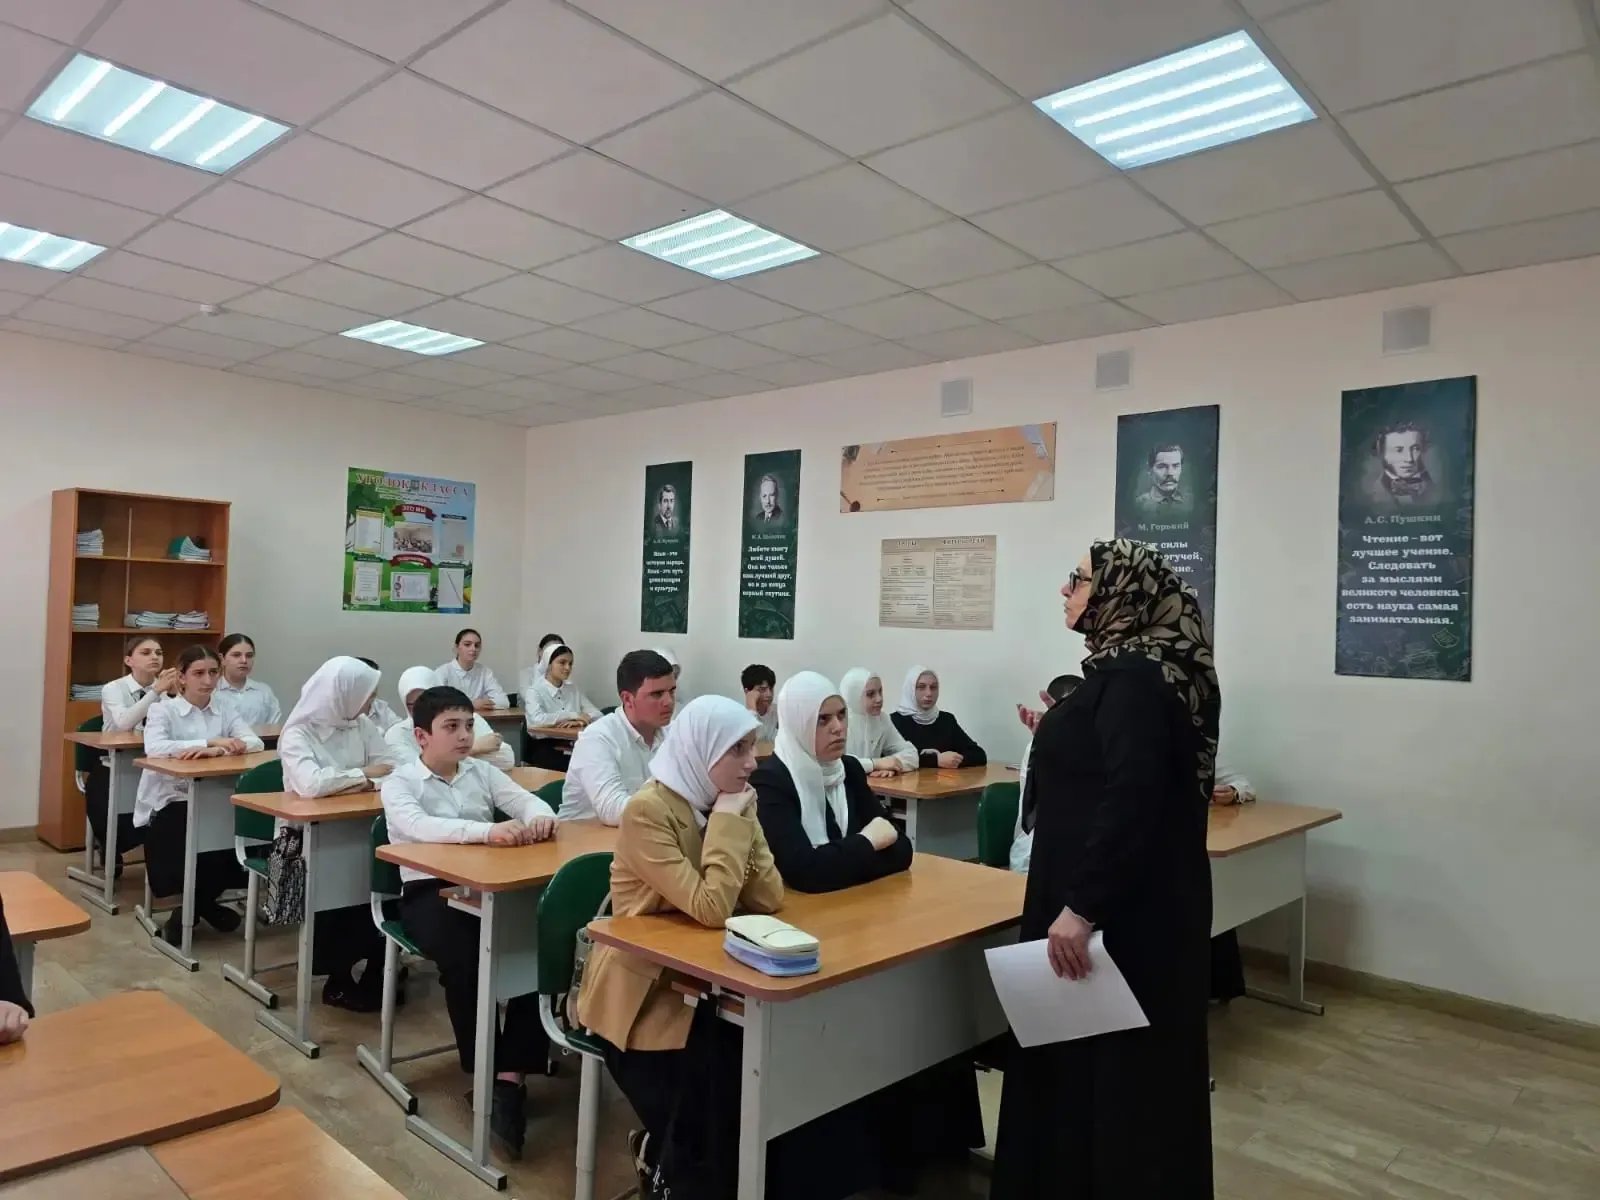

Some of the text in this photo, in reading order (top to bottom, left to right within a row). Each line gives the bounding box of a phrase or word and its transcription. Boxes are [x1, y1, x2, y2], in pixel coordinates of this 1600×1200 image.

[1391, 514, 1441, 525] Пушкин
[1150, 521, 1189, 532] Горький
[1363, 535, 1409, 543] Чтение
[1420, 534, 1443, 542] вот
[1161, 541, 1188, 549] силы
[1352, 547, 1454, 559] лучшее учение.
[1368, 561, 1436, 571] Следовать
[1361, 575, 1442, 584] за мыслями
[1342, 589, 1397, 598] великого
[1400, 589, 1460, 598] человека
[1377, 603, 1415, 612] наука
[1418, 603, 1458, 611] самая
[1349, 615, 1455, 625] занимательная.
